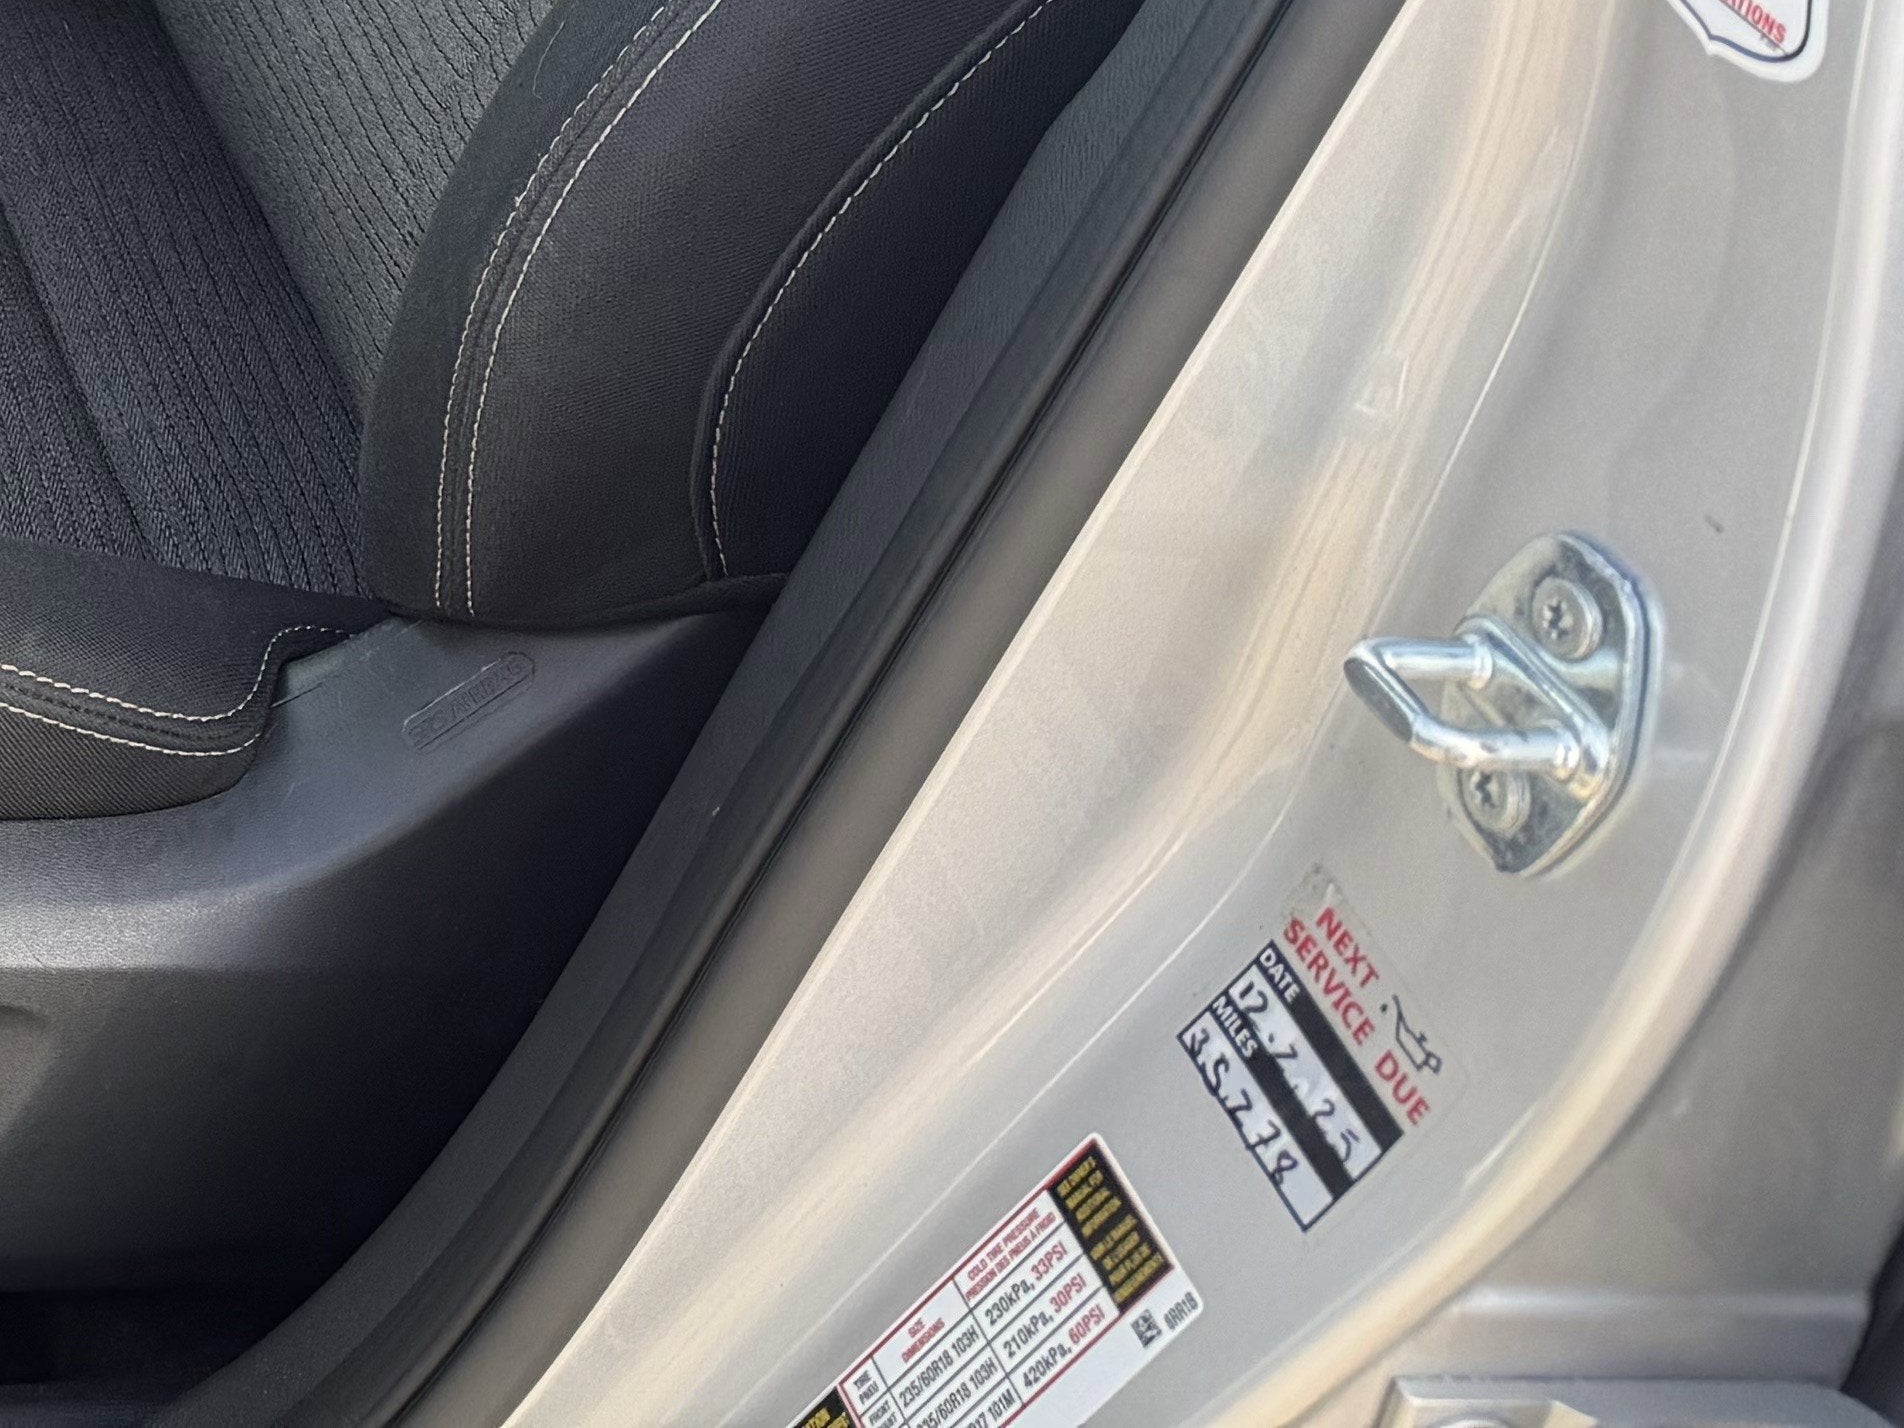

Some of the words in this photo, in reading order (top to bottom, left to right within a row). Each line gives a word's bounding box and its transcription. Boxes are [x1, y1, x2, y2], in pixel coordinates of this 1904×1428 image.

[1259, 947, 1300, 1004] DATE
[1315, 906, 1380, 989] NEXT
[1211, 996, 1259, 1058] MILES
[1282, 917, 1376, 1046] SERVICE
[1374, 1050, 1430, 1126] DUE
[966, 1257, 988, 1282] COLD
[985, 1241, 1003, 1263] TIRE
[1001, 1206, 1040, 1249] PRESSURE
[985, 1277, 1037, 1326] 230kPa,
[1030, 1241, 1068, 1282] 33PSI
[1003, 1308, 1055, 1359] 210kPa,
[1049, 1273, 1088, 1314] 30PSI
[1023, 1340, 1074, 1389] 420kPa,
[1068, 1304, 1106, 1345] 60PSI
[897, 1348, 954, 1408] 235/60R18
[950, 1323, 980, 1358] 103H
[969, 1357, 999, 1390] 103H
[988, 1388, 1016, 1422] 101M
